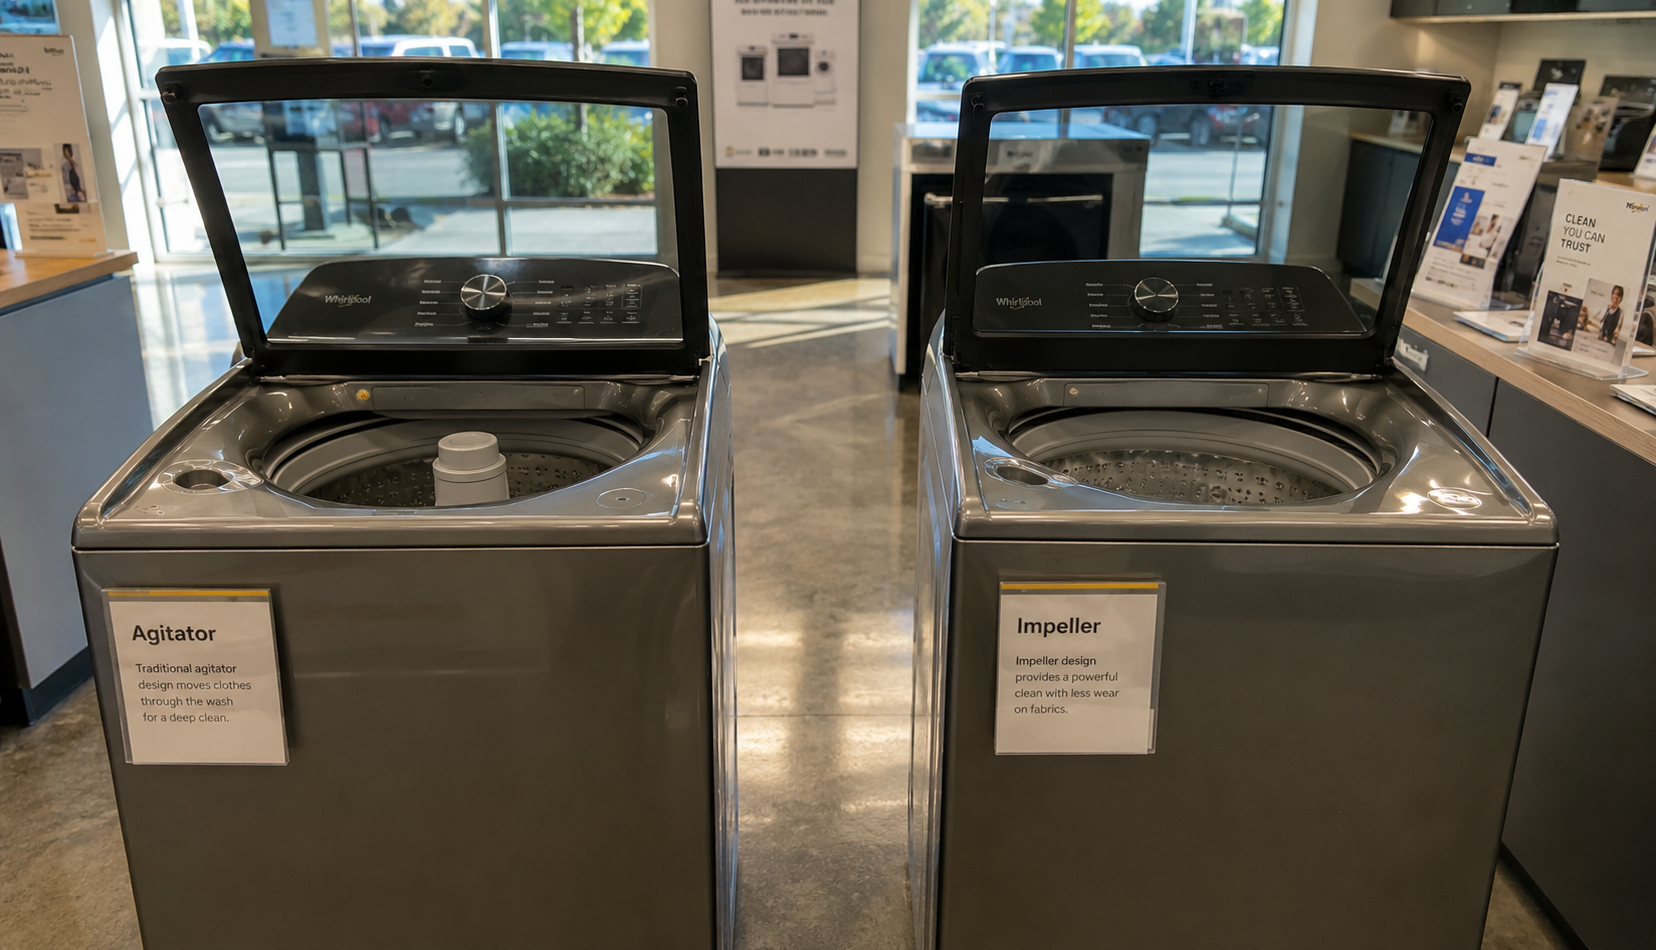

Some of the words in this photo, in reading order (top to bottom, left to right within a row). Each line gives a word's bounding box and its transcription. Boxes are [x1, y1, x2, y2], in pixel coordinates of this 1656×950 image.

[1565, 213, 1596, 228] CLEAN
[1563, 226, 1583, 239] YOU
[1584, 230, 1606, 243] CAN
[1561, 239, 1591, 253] TRUST
[325, 295, 372, 307] Whirlpool
[996, 297, 1042, 309] Whirlpool
[1018, 618, 1101, 637] Impeller
[132, 625, 216, 645] Agitator
[1016, 656, 1058, 667] Impeller
[1062, 656, 1096, 667] design
[136, 664, 192, 673] Traditional
[195, 664, 236, 675] agitator
[1016, 672, 1060, 683] provides
[1071, 672, 1118, 683] powerful
[138, 680, 173, 691] design
[213, 681, 251, 690] clothes
[1015, 689, 1042, 698] clean
[1045, 688, 1068, 697] with
[1071, 689, 1090, 697] less
[141, 697, 182, 708] through
[186, 697, 203, 706] the
[206, 697, 233, 706] wash
[1030, 705, 1068, 713] fabrics.
[143, 712, 158, 722] for
[160, 714, 167, 722] a
[170, 713, 195, 724] deep
[199, 713, 229, 722] clean.
